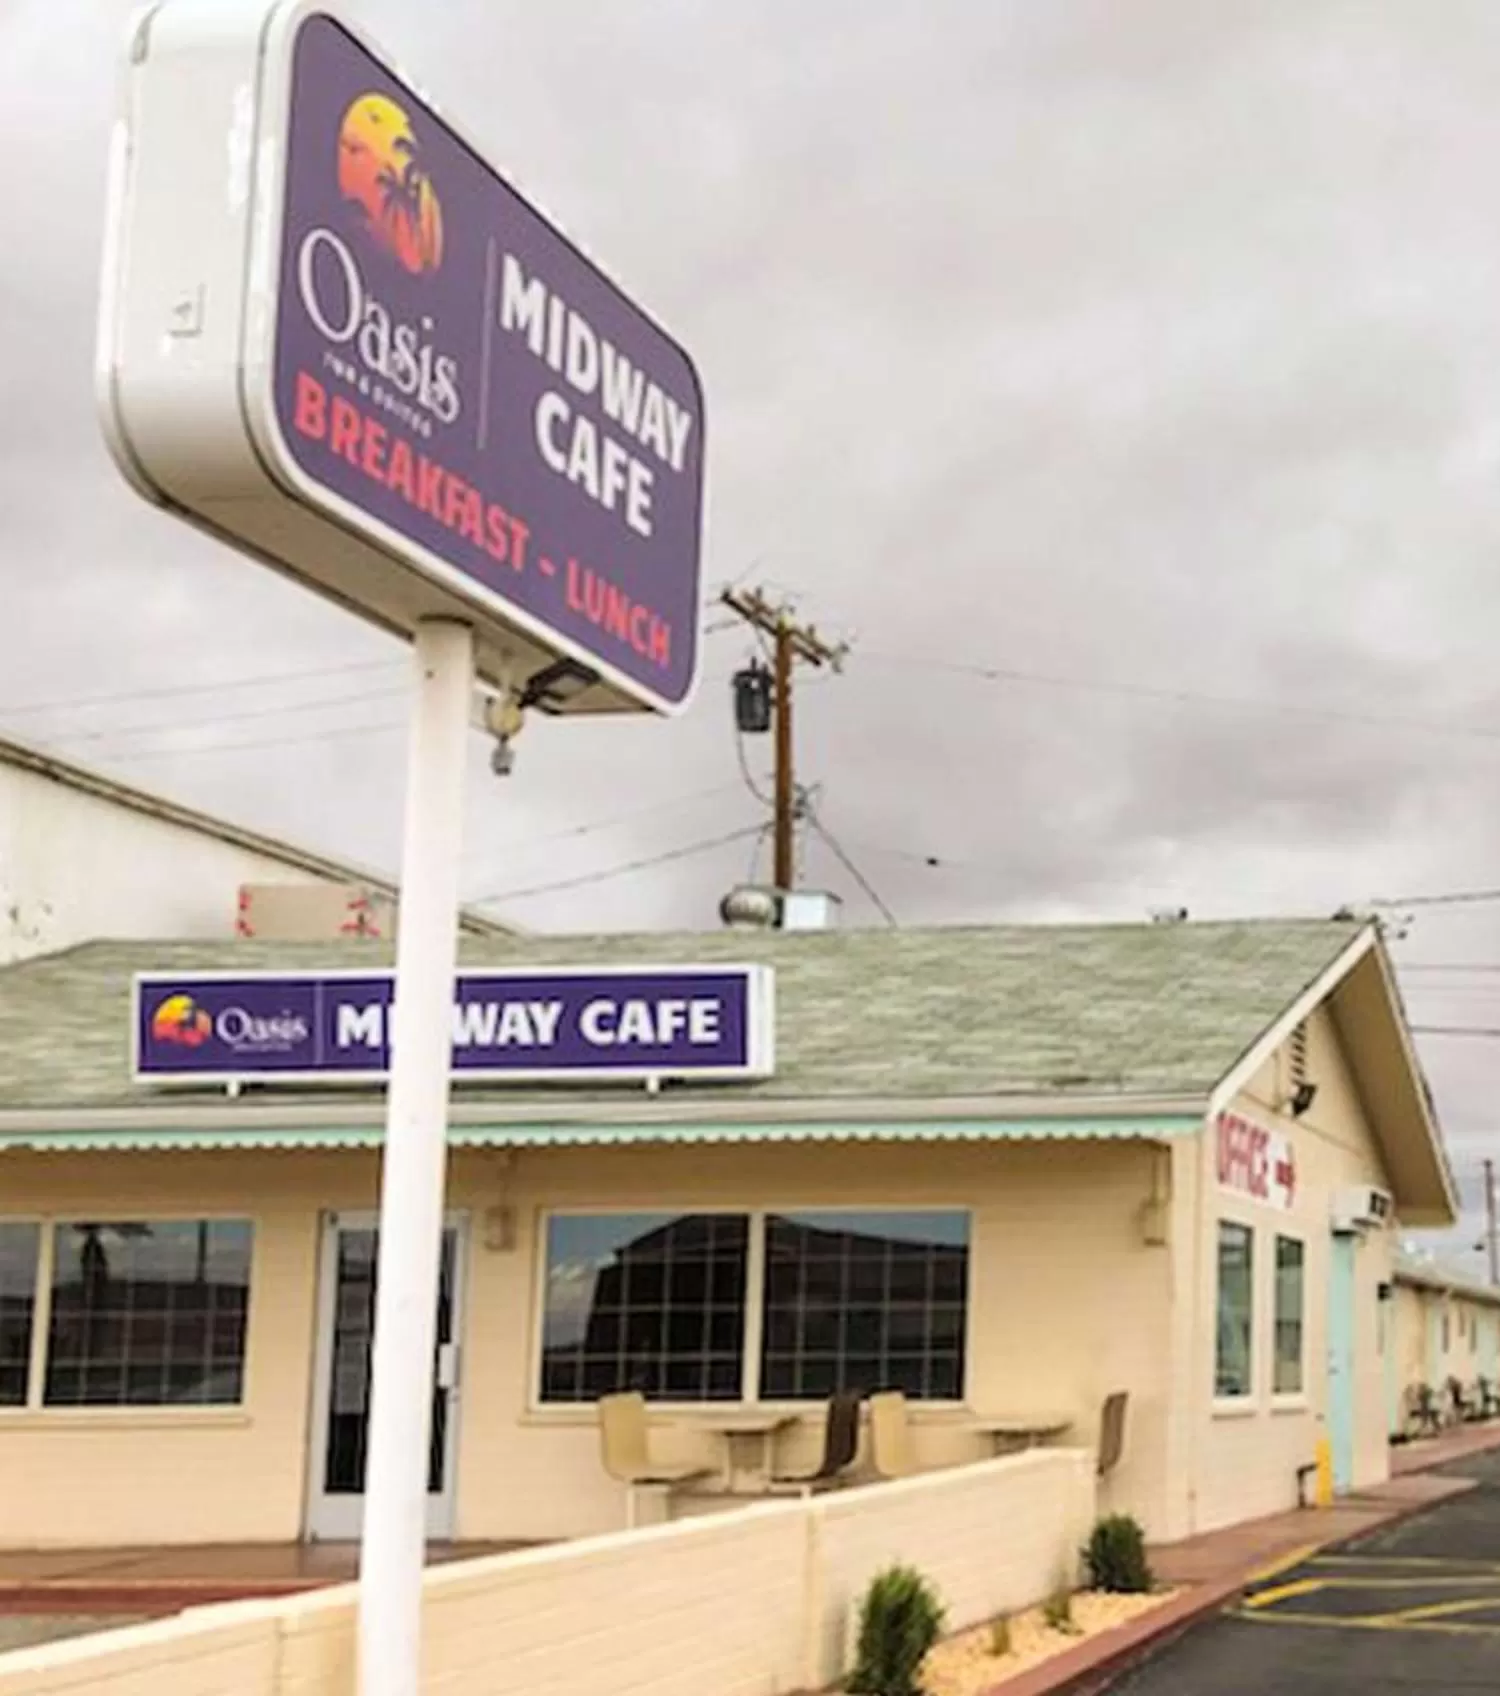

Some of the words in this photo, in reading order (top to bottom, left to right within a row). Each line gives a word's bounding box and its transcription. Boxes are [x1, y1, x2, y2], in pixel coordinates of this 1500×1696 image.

[299, 228, 459, 424] Oasis
[501, 252, 692, 473] MIDWAY
[294, 370, 530, 572] BREAKFAST
[565, 556, 672, 669] LUNCH
[536, 390, 654, 537] CAFE
[216, 1006, 308, 1043] Oasis
[580, 1000, 721, 1044] CAFE
